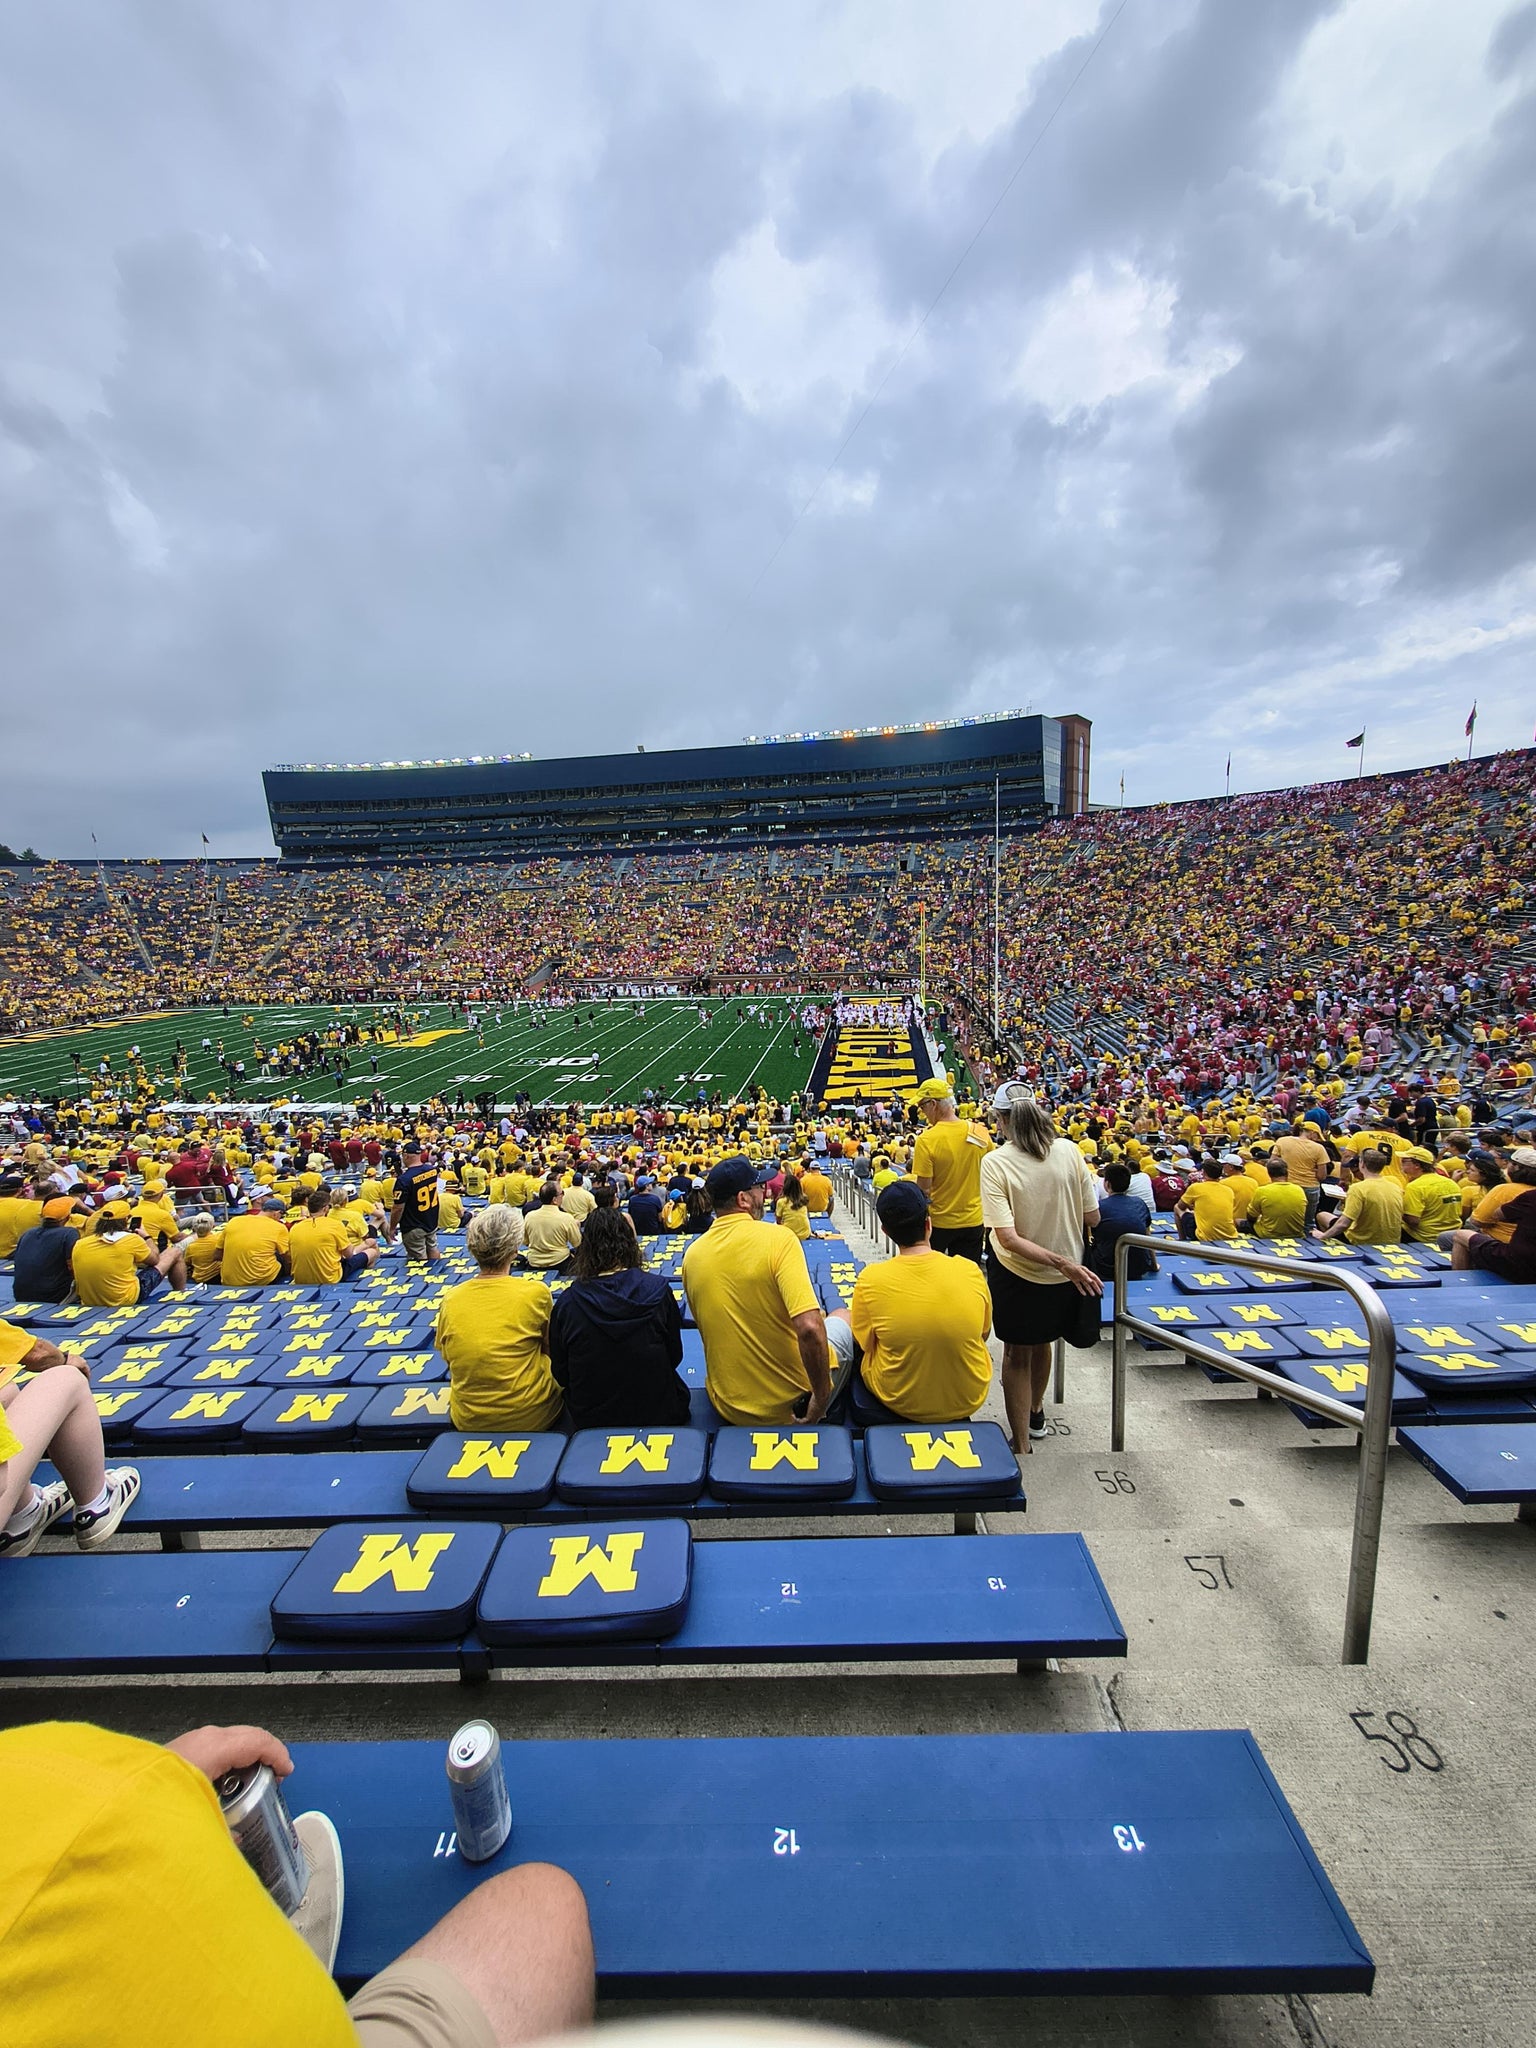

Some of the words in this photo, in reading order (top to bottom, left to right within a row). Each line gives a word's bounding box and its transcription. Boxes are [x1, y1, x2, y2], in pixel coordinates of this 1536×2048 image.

[554, 1074, 600, 1082] 20
[417, 1181, 439, 1212] 97
[1381, 1254, 1423, 1265] M
[1252, 1271, 1295, 1283] M
[1376, 1267, 1422, 1279] M
[1, 1304, 43, 1316] M
[51, 1306, 93, 1319] M
[107, 1305, 149, 1319] M
[357, 1312, 400, 1328] M
[1150, 1306, 1200, 1321] M
[1228, 1304, 1284, 1322] M
[79, 1320, 127, 1336] M
[149, 1318, 195, 1334] M
[219, 1316, 262, 1331] M
[288, 1313, 332, 1329] M
[207, 1332, 259, 1351] M
[282, 1331, 333, 1352] M
[364, 1328, 412, 1346] M
[1211, 1330, 1274, 1351] M
[1305, 1327, 1370, 1349] M
[1404, 1326, 1476, 1348] M
[123, 1342, 170, 1359] M
[99, 1361, 164, 1382] M
[192, 1358, 255, 1380] M
[285, 1355, 345, 1377] M
[378, 1353, 433, 1376] M
[1414, 1353, 1500, 1370] M
[168, 1391, 246, 1419] M
[275, 1393, 348, 1422] M
[391, 1387, 450, 1416] M
[1044, 1418, 1071, 1436] 55
[448, 1441, 530, 1478] M
[600, 1435, 673, 1473] M
[750, 1433, 818, 1469] M
[905, 1431, 980, 1470] M
[1094, 1470, 1136, 1494] 56
[334, 1534, 453, 1592] M
[538, 1533, 643, 1596] M
[1184, 1555, 1235, 1590] 57
[781, 1582, 798, 1596] 12
[987, 1577, 1007, 1591] 13
[1349, 1710, 1444, 1773] 58
[433, 1831, 457, 1857] 11
[772, 1826, 801, 1855] 12
[1113, 1823, 1147, 1852] 13
